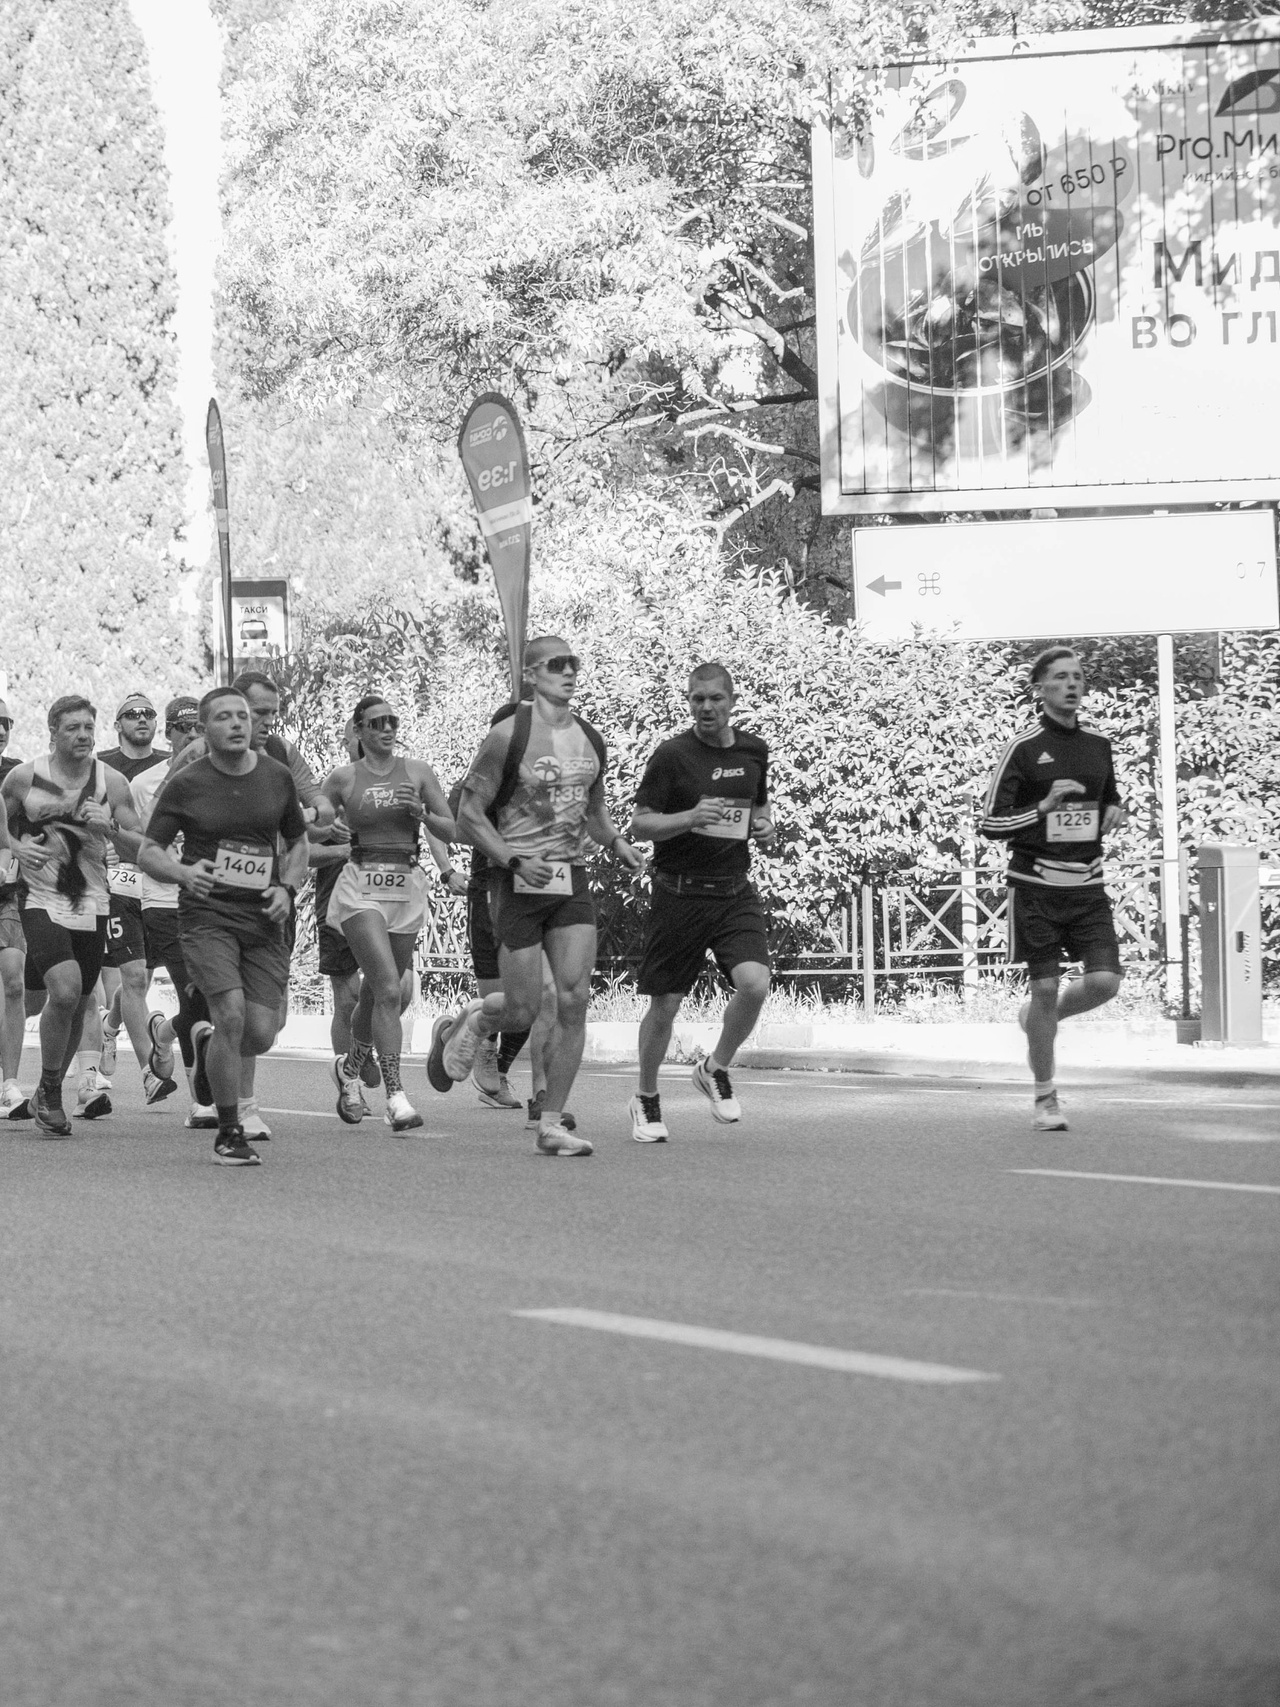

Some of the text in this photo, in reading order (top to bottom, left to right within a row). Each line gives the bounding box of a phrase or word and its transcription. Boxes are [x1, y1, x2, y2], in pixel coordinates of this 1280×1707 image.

[1060, 164, 1105, 194] 650
[240, 606, 268, 614] ТАКСИ
[547, 785, 584, 802] 1:39
[1055, 812, 1091, 827] 1226
[224, 856, 266, 876] 1404
[112, 870, 136, 885] 734
[365, 873, 405, 888] 1082
